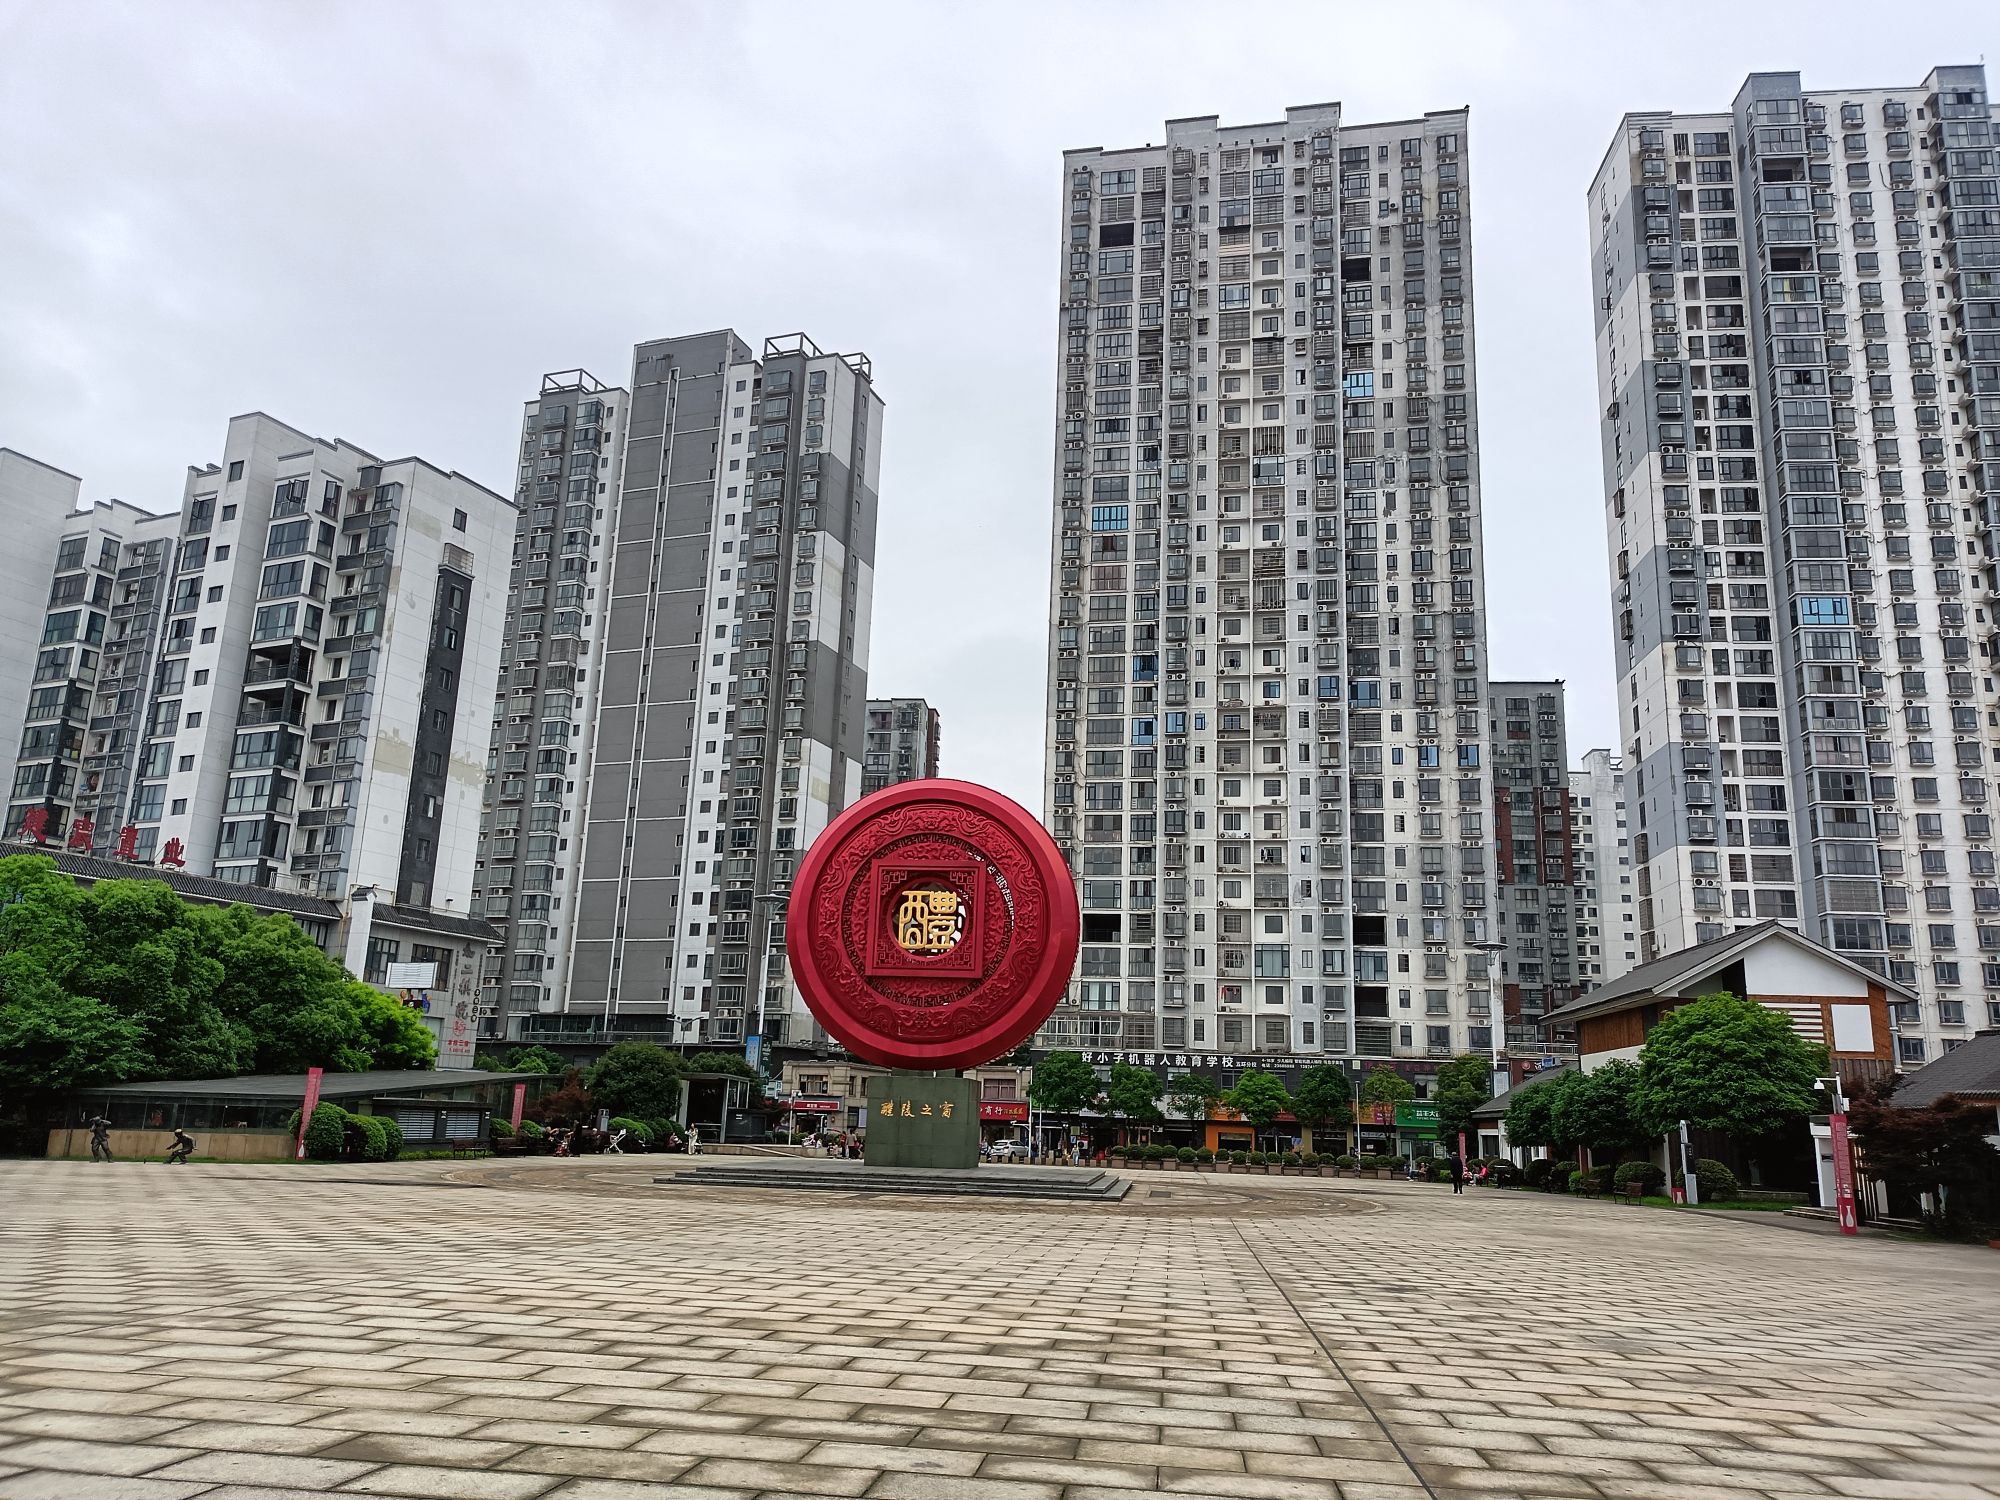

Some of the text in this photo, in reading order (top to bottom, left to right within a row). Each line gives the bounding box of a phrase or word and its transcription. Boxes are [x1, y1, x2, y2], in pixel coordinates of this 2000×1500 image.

[1082, 1052, 1233, 1068] 好小子机器人教育学校
